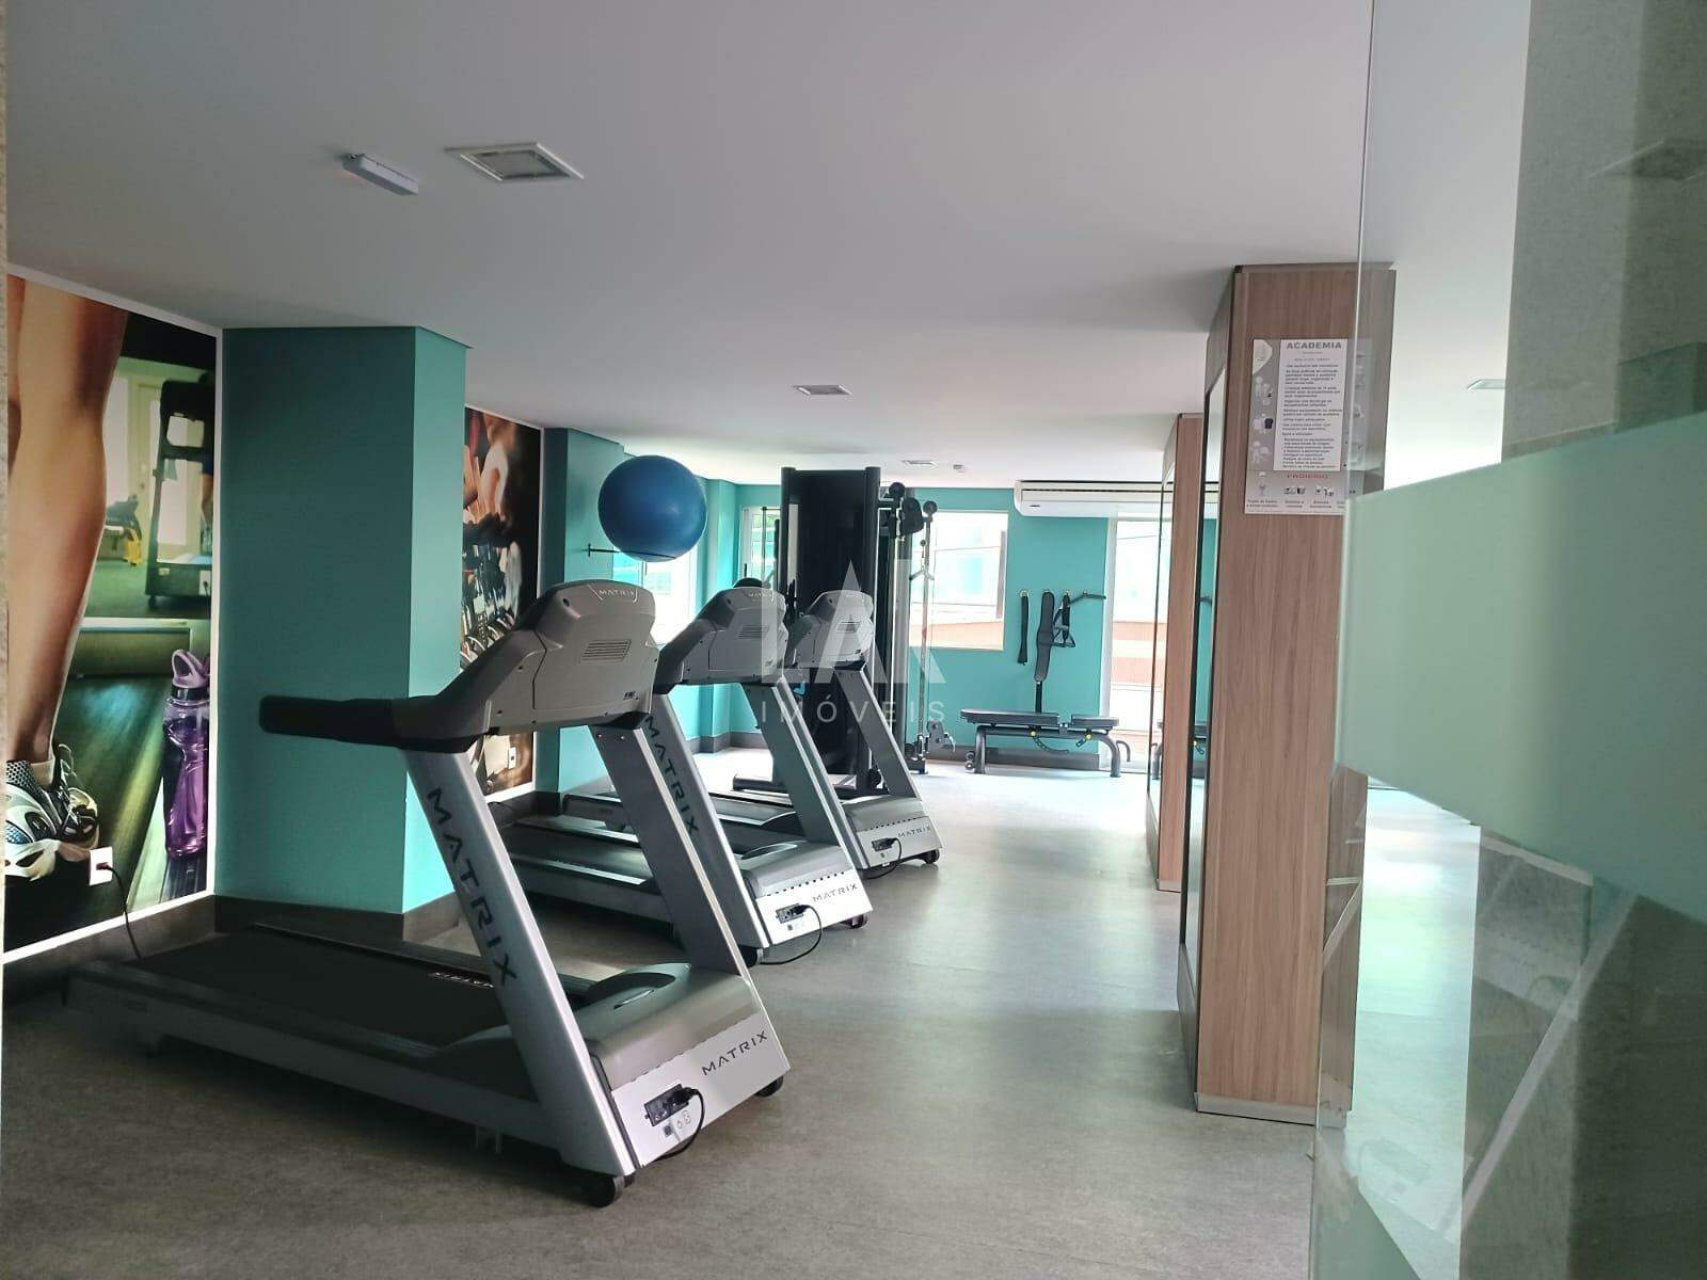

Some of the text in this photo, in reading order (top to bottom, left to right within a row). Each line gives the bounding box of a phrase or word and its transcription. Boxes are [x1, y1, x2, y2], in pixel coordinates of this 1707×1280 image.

[1286, 342, 1342, 350] ACADEMIA
[599, 589, 635, 597] MATRIX
[644, 716, 699, 836] MATRIX
[898, 825, 932, 838] MATRIX
[427, 788, 517, 985] MATRIX
[812, 882, 859, 902] MATRIX
[701, 1030, 768, 1076] MATRIX
